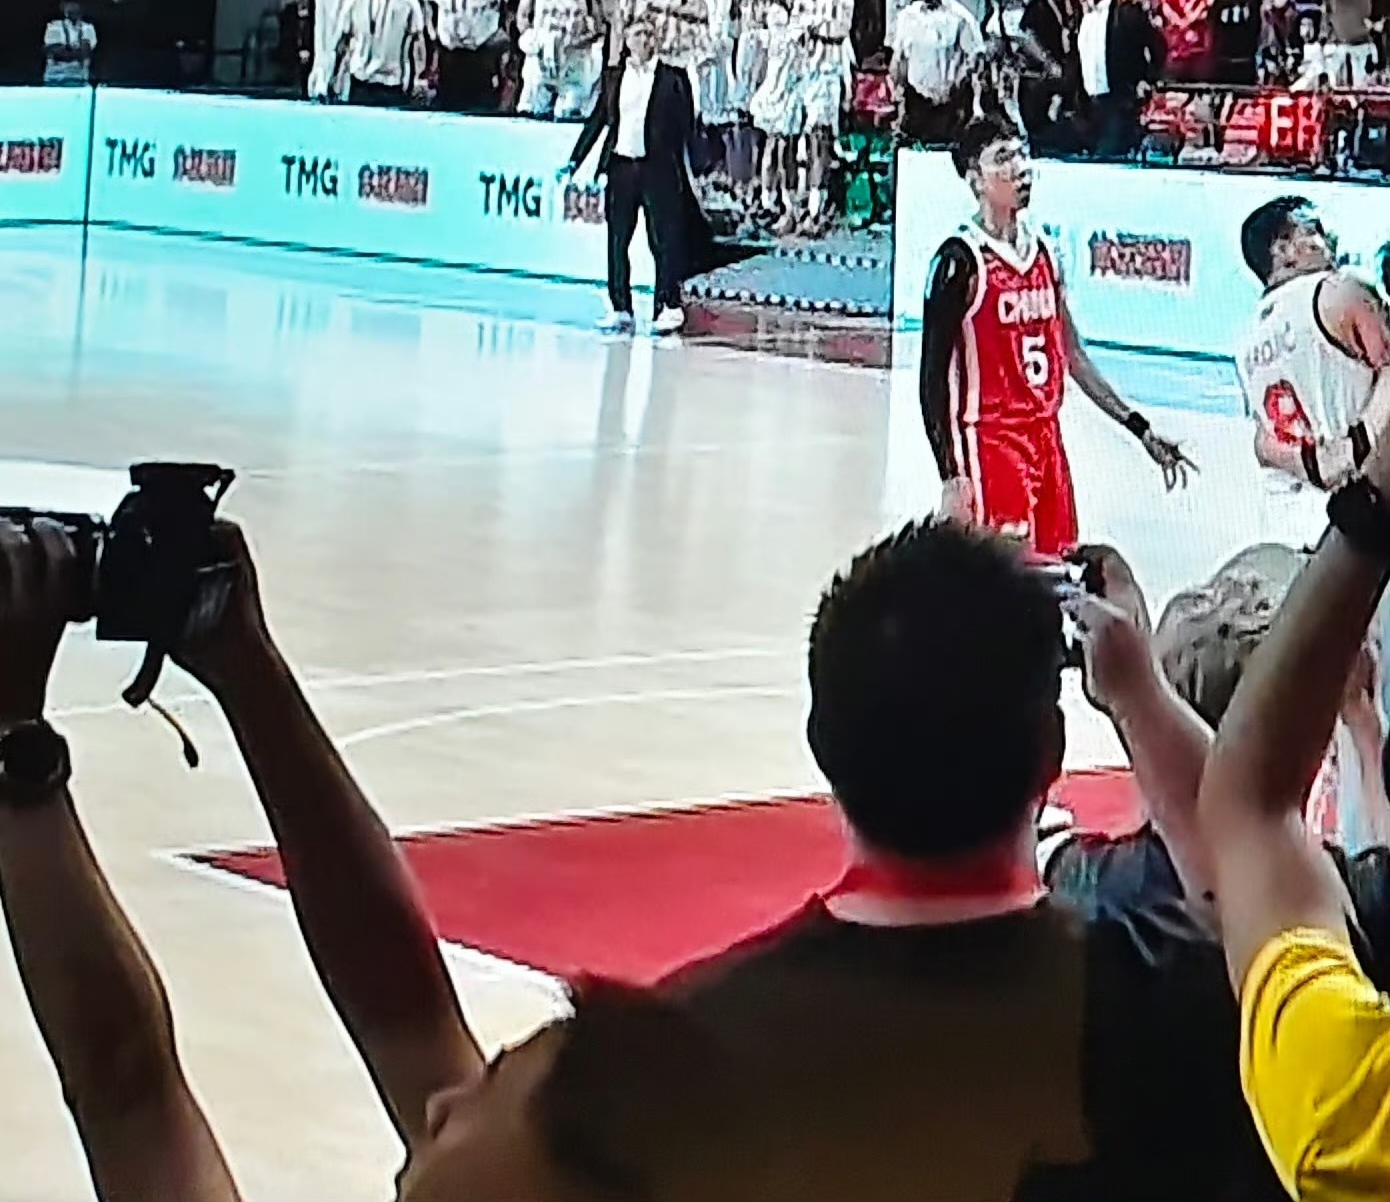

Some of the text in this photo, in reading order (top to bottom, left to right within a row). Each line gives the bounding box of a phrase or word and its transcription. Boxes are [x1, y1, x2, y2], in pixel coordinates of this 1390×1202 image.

[105, 137, 156, 179] TMG
[281, 155, 338, 198] TMG
[479, 171, 541, 218] TMG
[1021, 334, 1049, 387] 5
